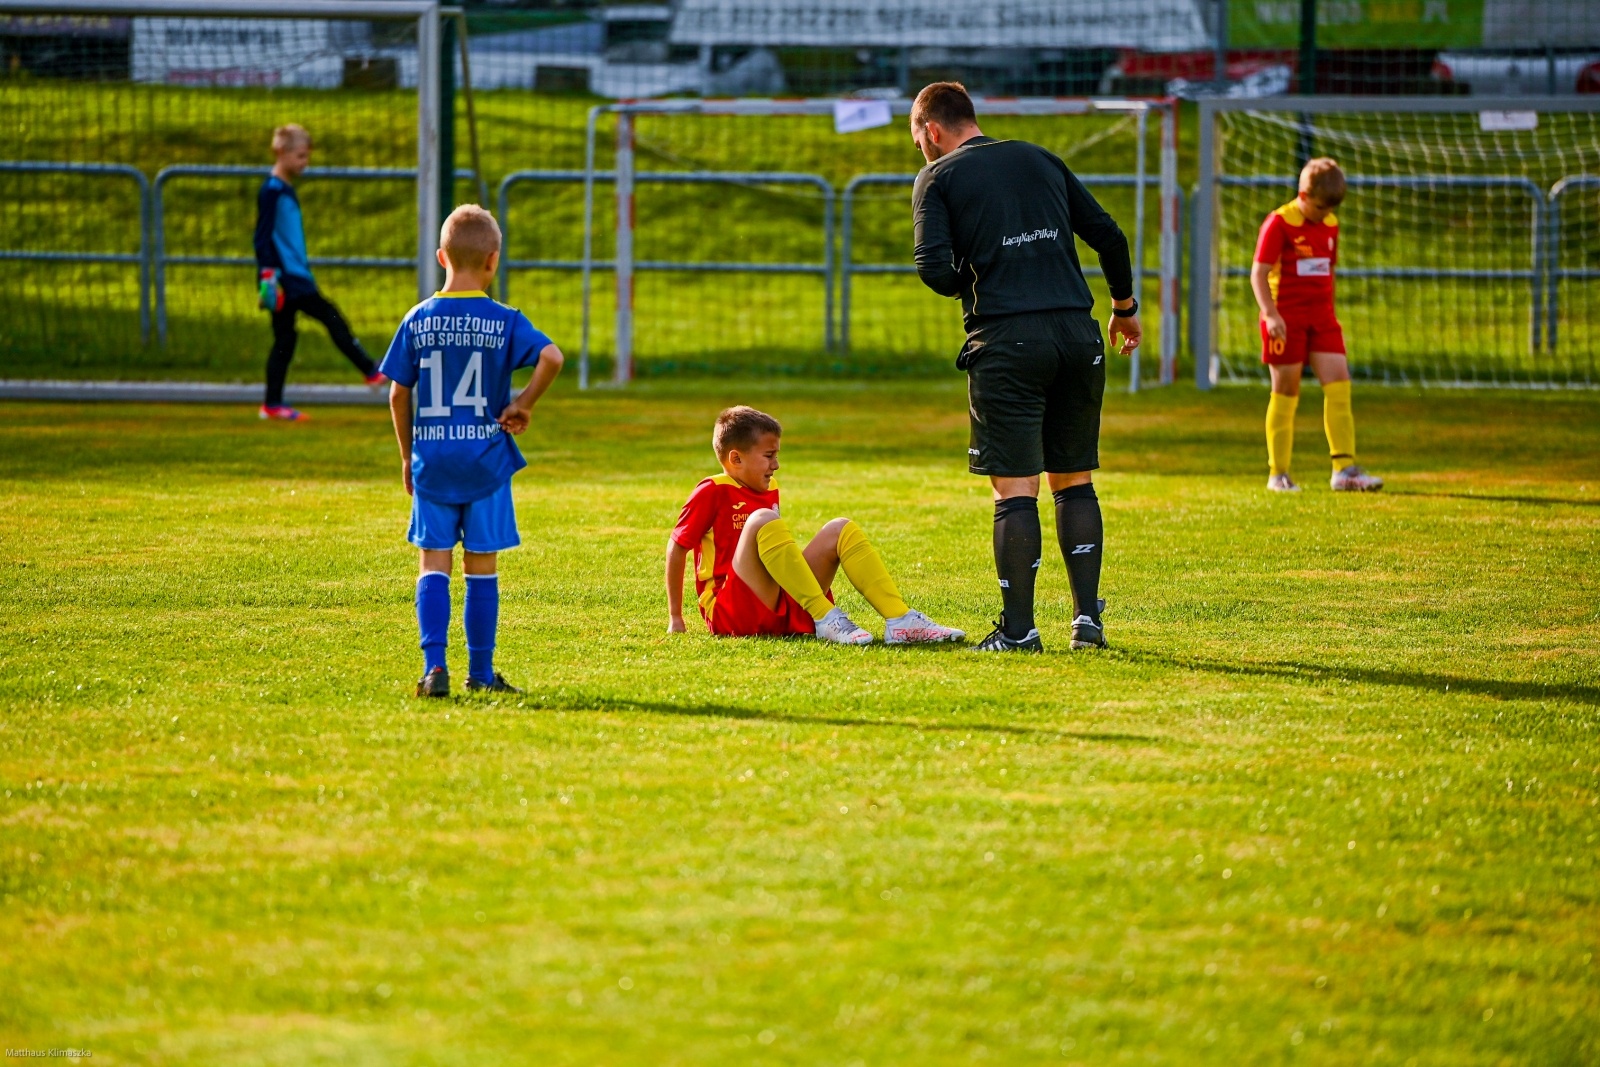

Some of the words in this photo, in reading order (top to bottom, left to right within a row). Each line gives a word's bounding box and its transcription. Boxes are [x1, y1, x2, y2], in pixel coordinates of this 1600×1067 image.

[438, 332, 505, 349] SPORTOWY
[1269, 338, 1285, 356] 10
[419, 350, 488, 418] 14
[413, 424, 445, 441] MINA
[449, 423, 502, 440] LUBOM
